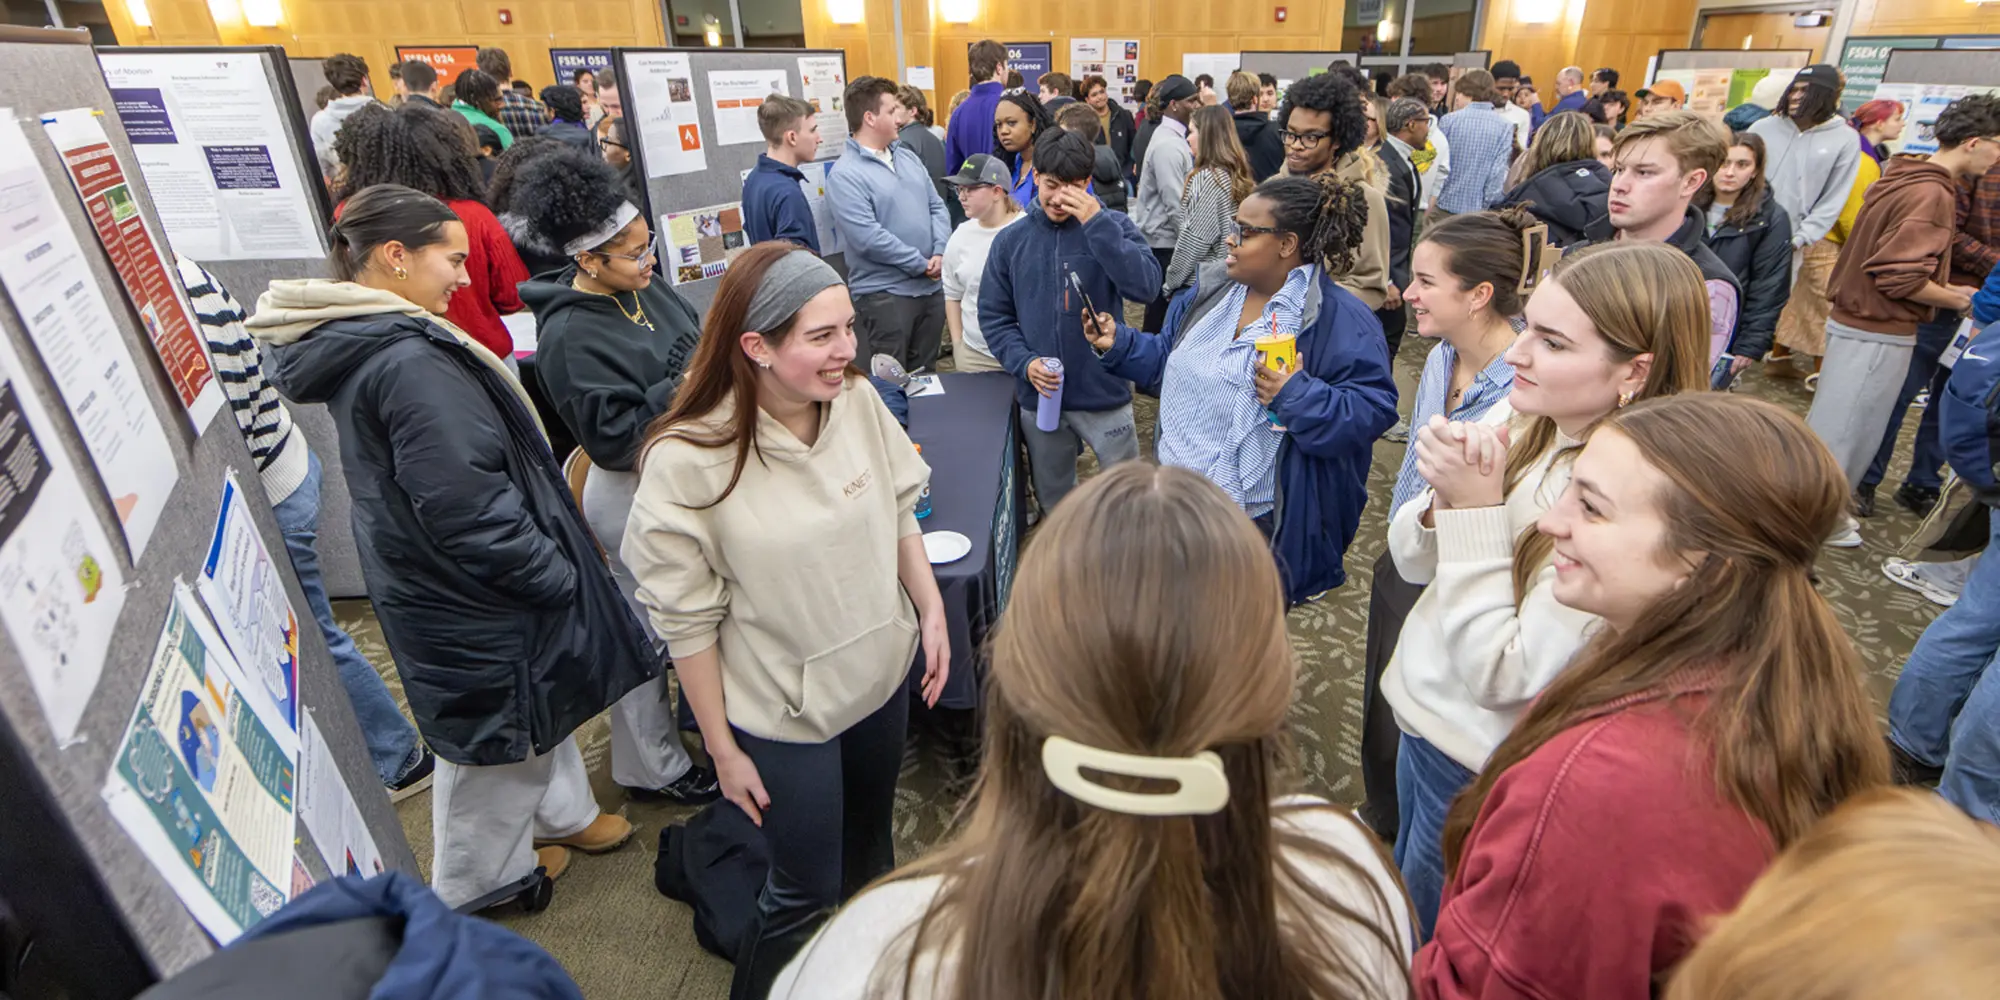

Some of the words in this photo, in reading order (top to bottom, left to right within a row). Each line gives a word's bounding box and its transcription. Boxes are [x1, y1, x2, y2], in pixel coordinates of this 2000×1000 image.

[1848, 46, 1879, 59] FSEM
[558, 56, 586, 66] FSEM
[588, 56, 608, 66] 058
